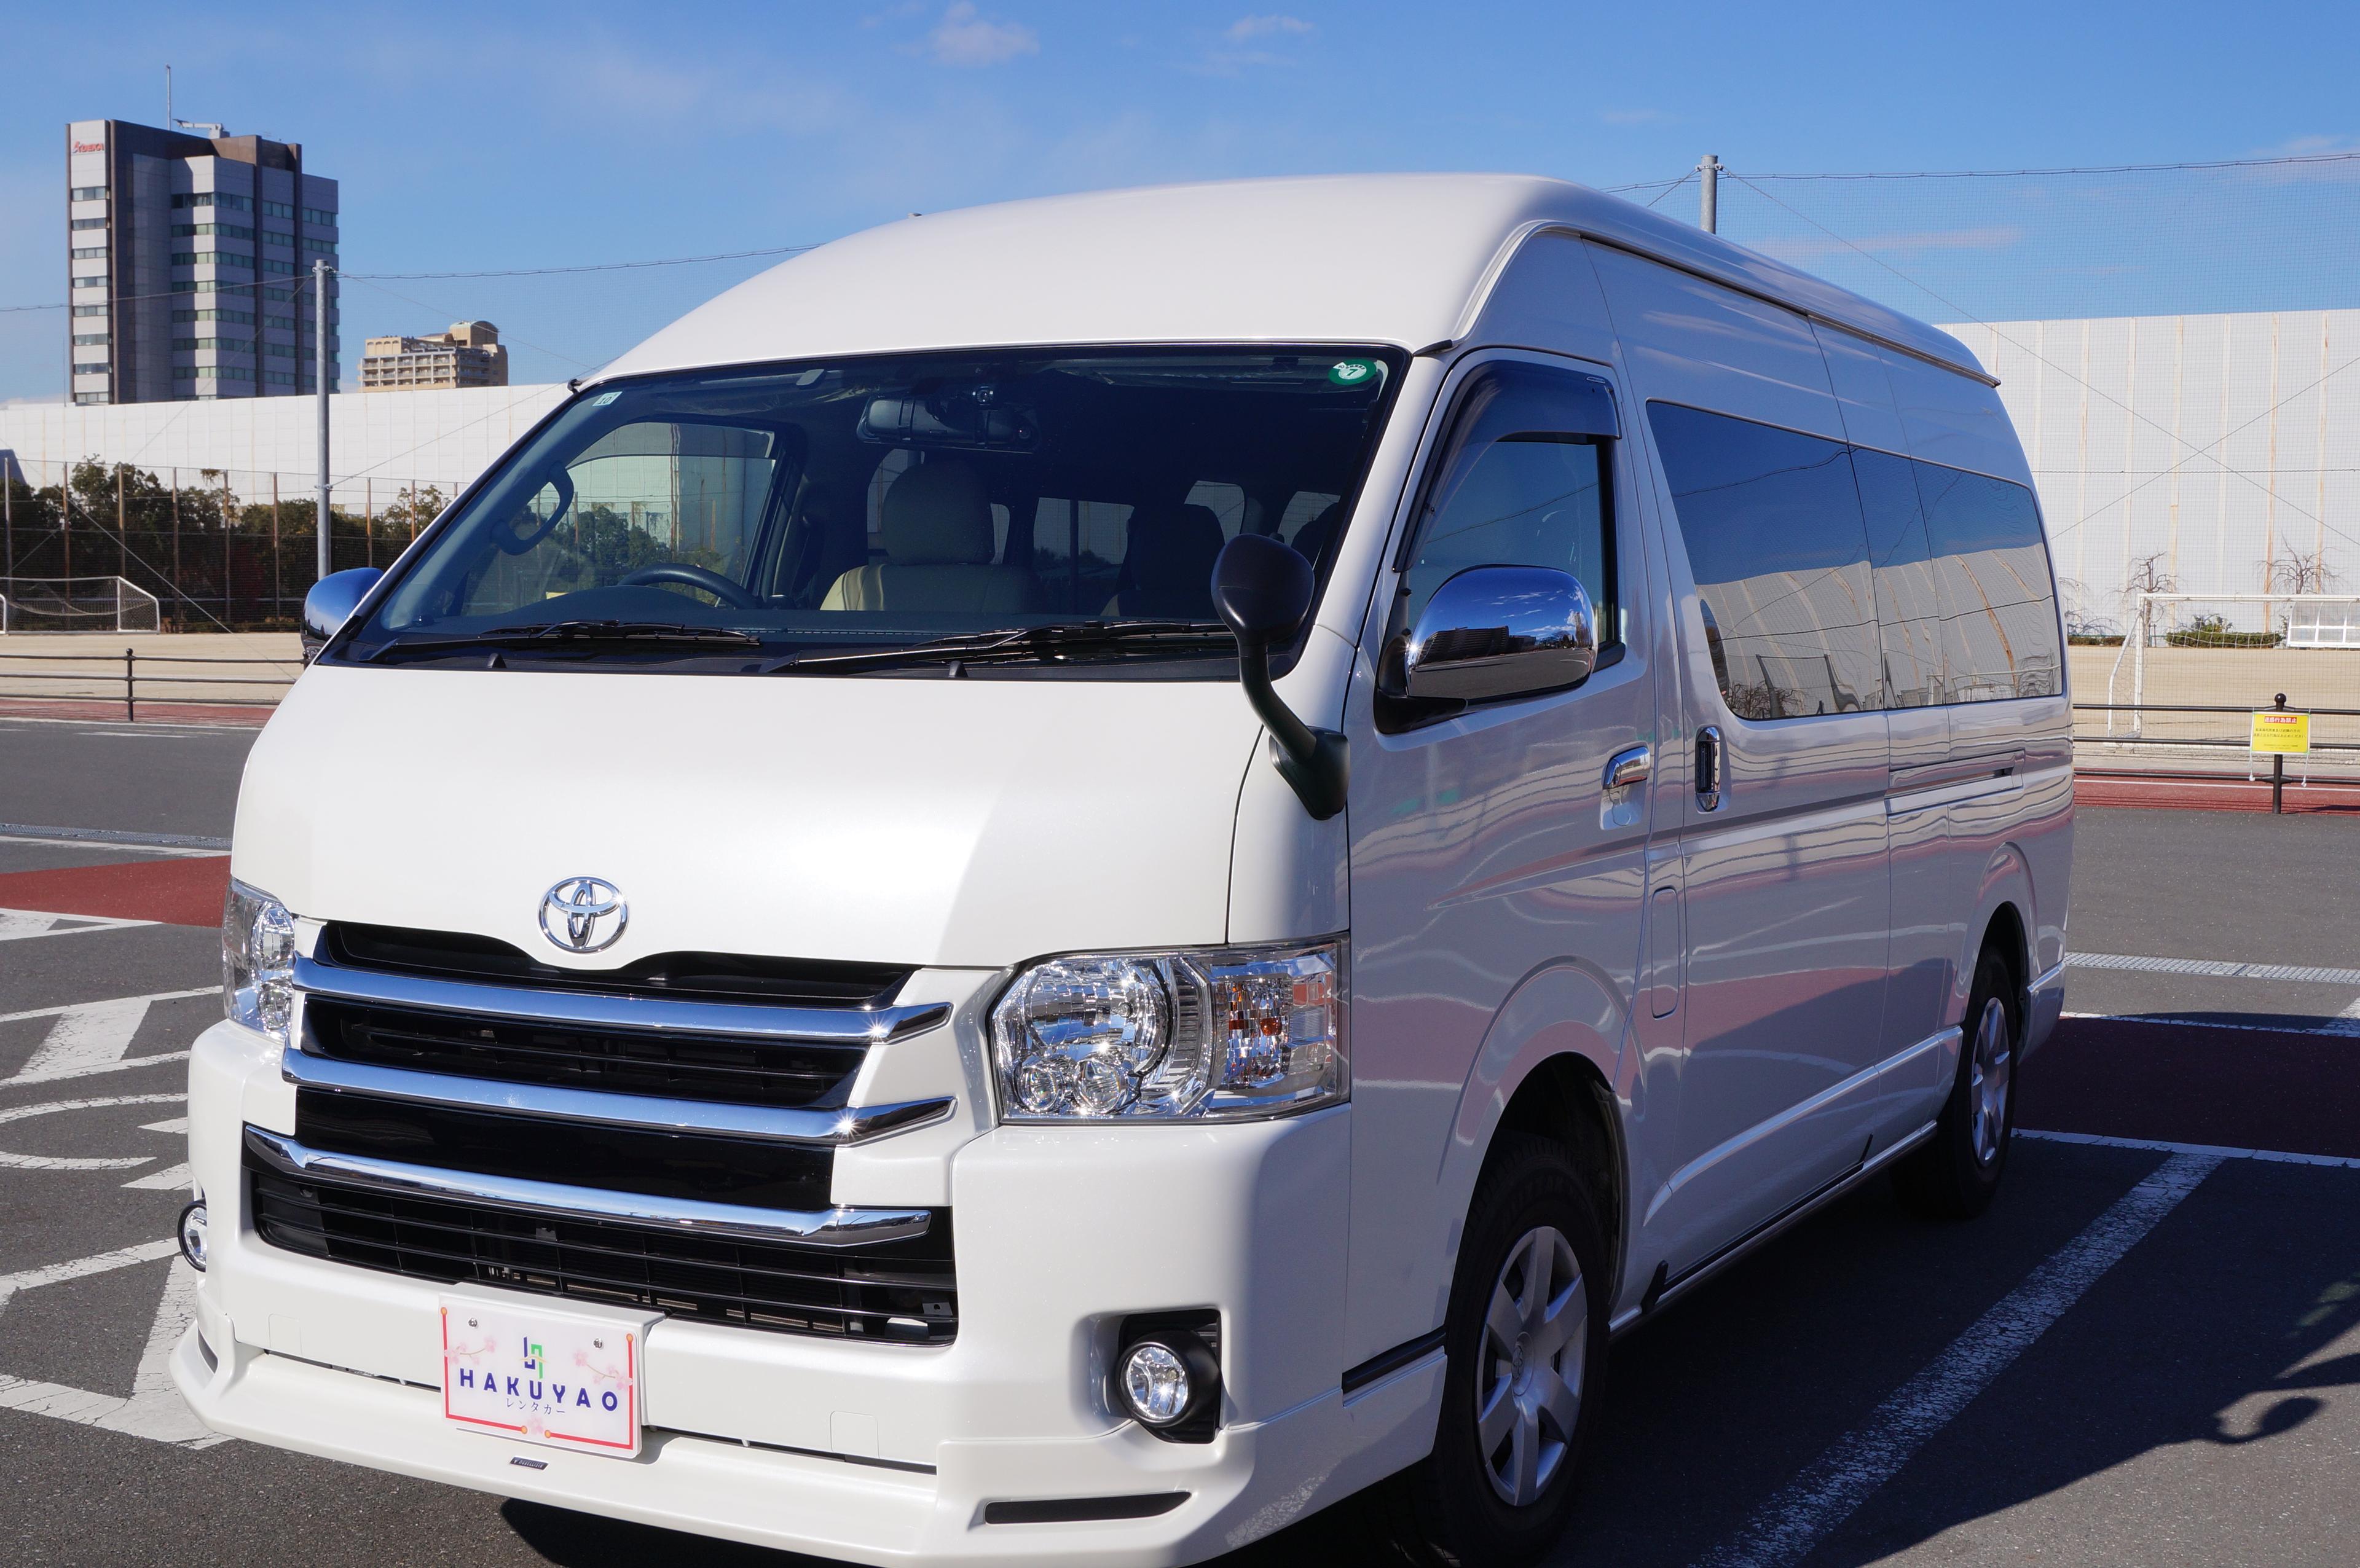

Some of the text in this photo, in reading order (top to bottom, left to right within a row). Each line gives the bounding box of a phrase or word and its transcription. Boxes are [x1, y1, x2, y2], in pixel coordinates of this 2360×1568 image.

[460, 1368, 618, 1411] HAKUYAO
[506, 1398, 565, 1415] レンタカー
